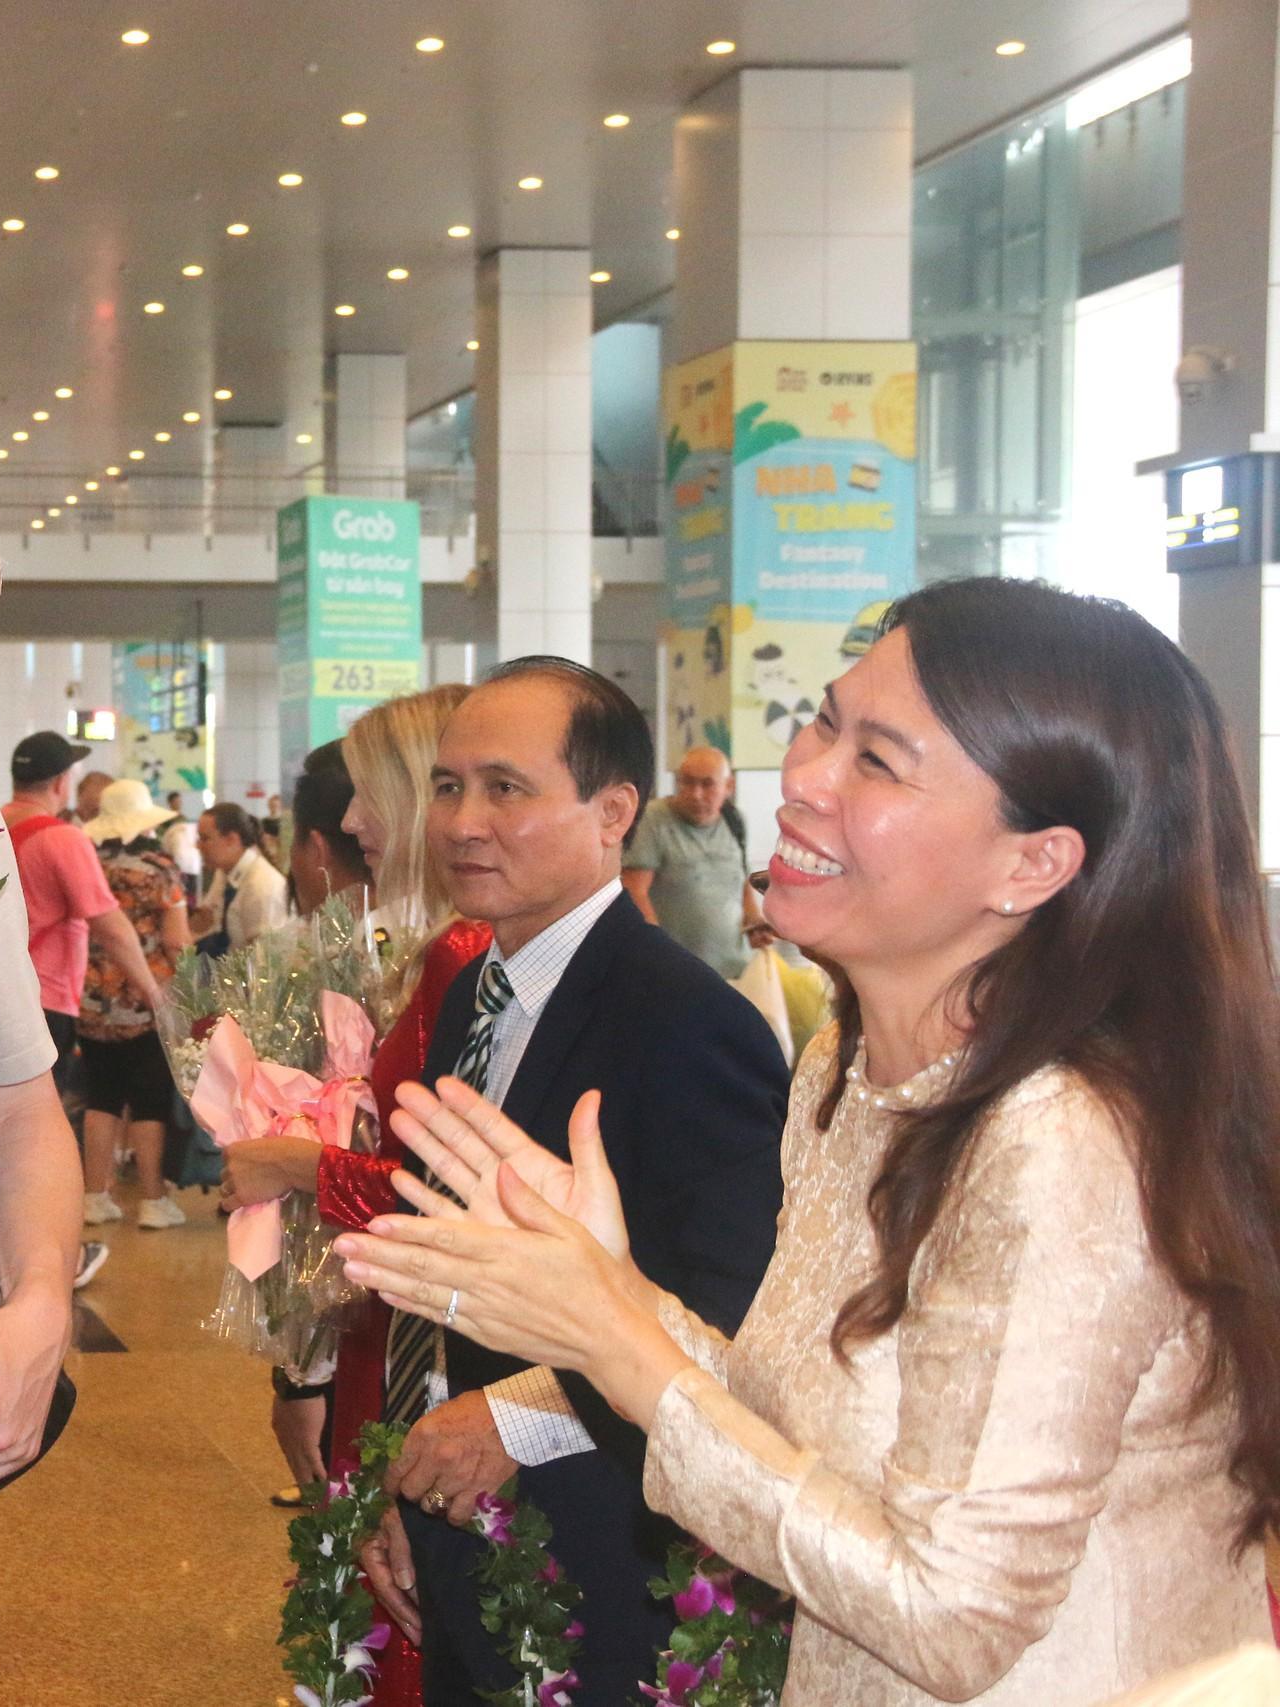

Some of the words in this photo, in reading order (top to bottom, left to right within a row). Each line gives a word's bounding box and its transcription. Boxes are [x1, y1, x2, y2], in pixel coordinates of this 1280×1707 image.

[756, 464, 838, 496] NHA
[332, 508, 396, 542] Grab
[773, 502, 896, 533] TRANG
[349, 552, 412, 571] GrabCar
[759, 569, 888, 589] Destination
[331, 665, 375, 691] 263
